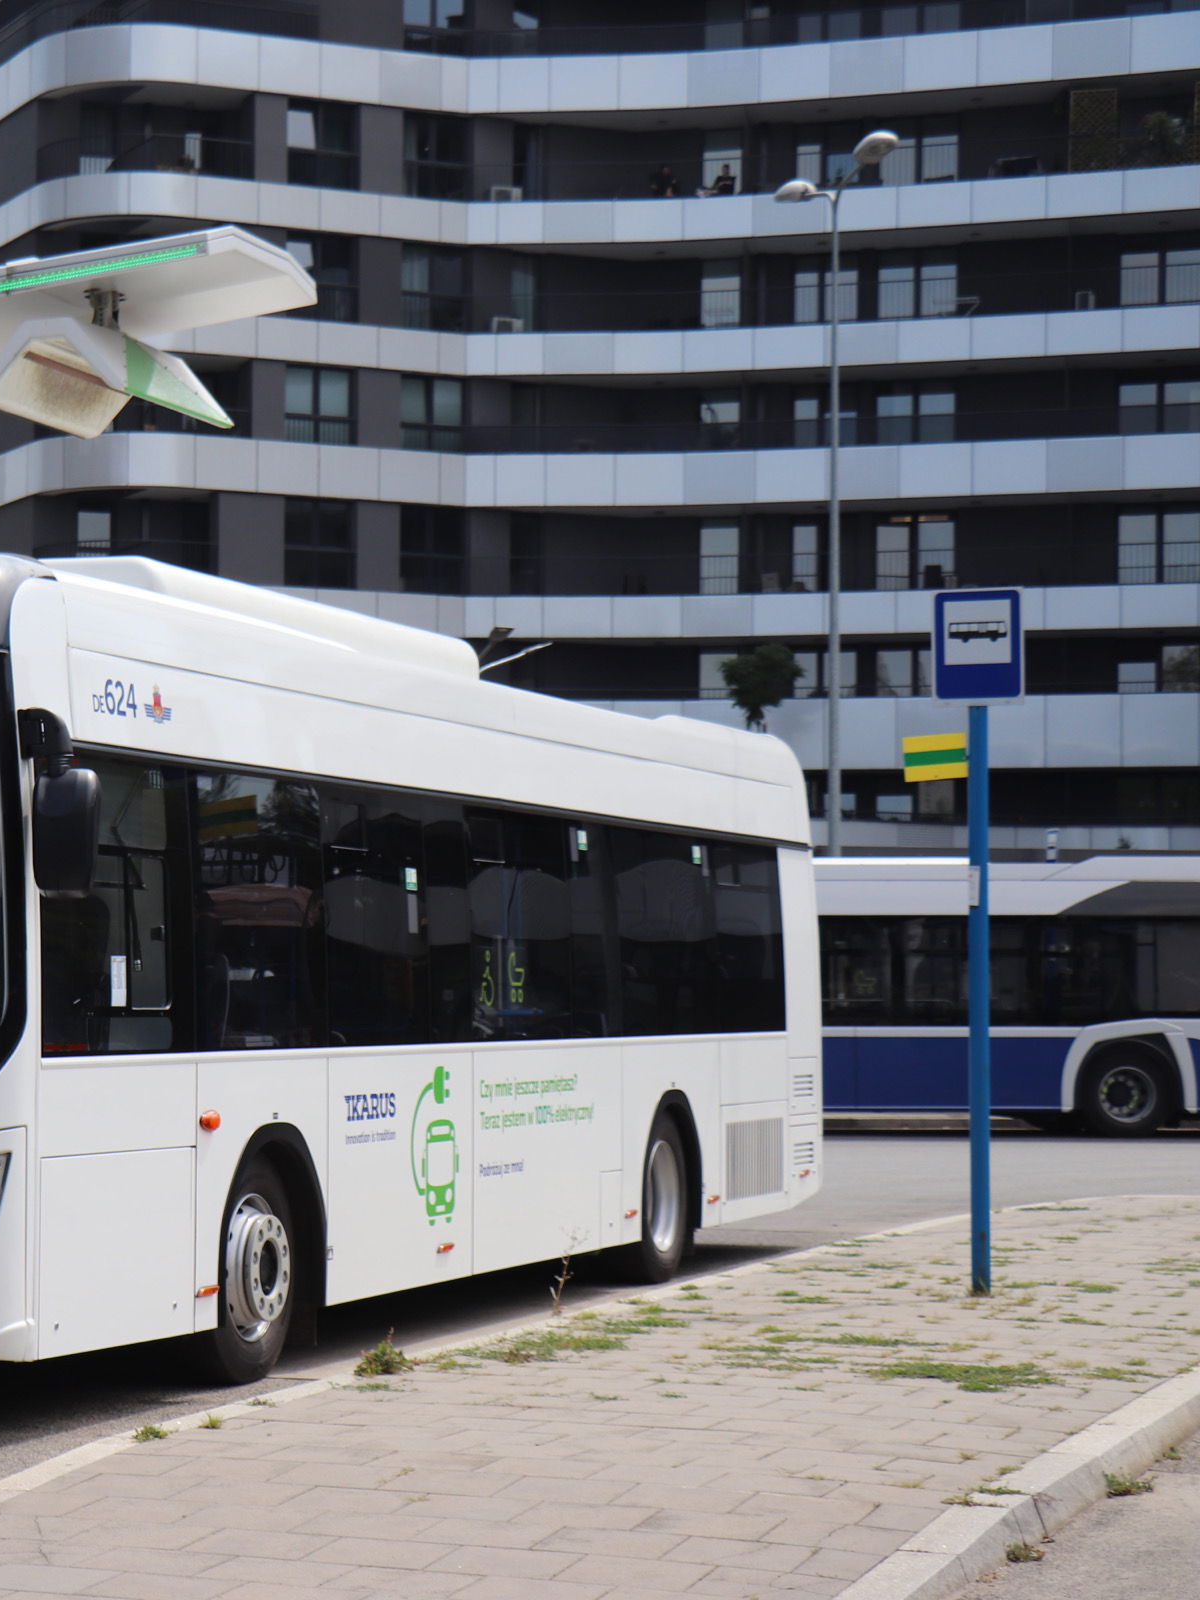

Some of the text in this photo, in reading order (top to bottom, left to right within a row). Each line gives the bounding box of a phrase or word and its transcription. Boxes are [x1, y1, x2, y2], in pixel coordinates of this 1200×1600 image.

[480, 1080, 493, 1103] Czy
[495, 1077, 512, 1097] mnie
[344, 1092, 397, 1121] IKARUS
[480, 1111, 500, 1130] Teraz
[501, 1109, 526, 1134] jestem
[535, 1104, 555, 1124] 100%
